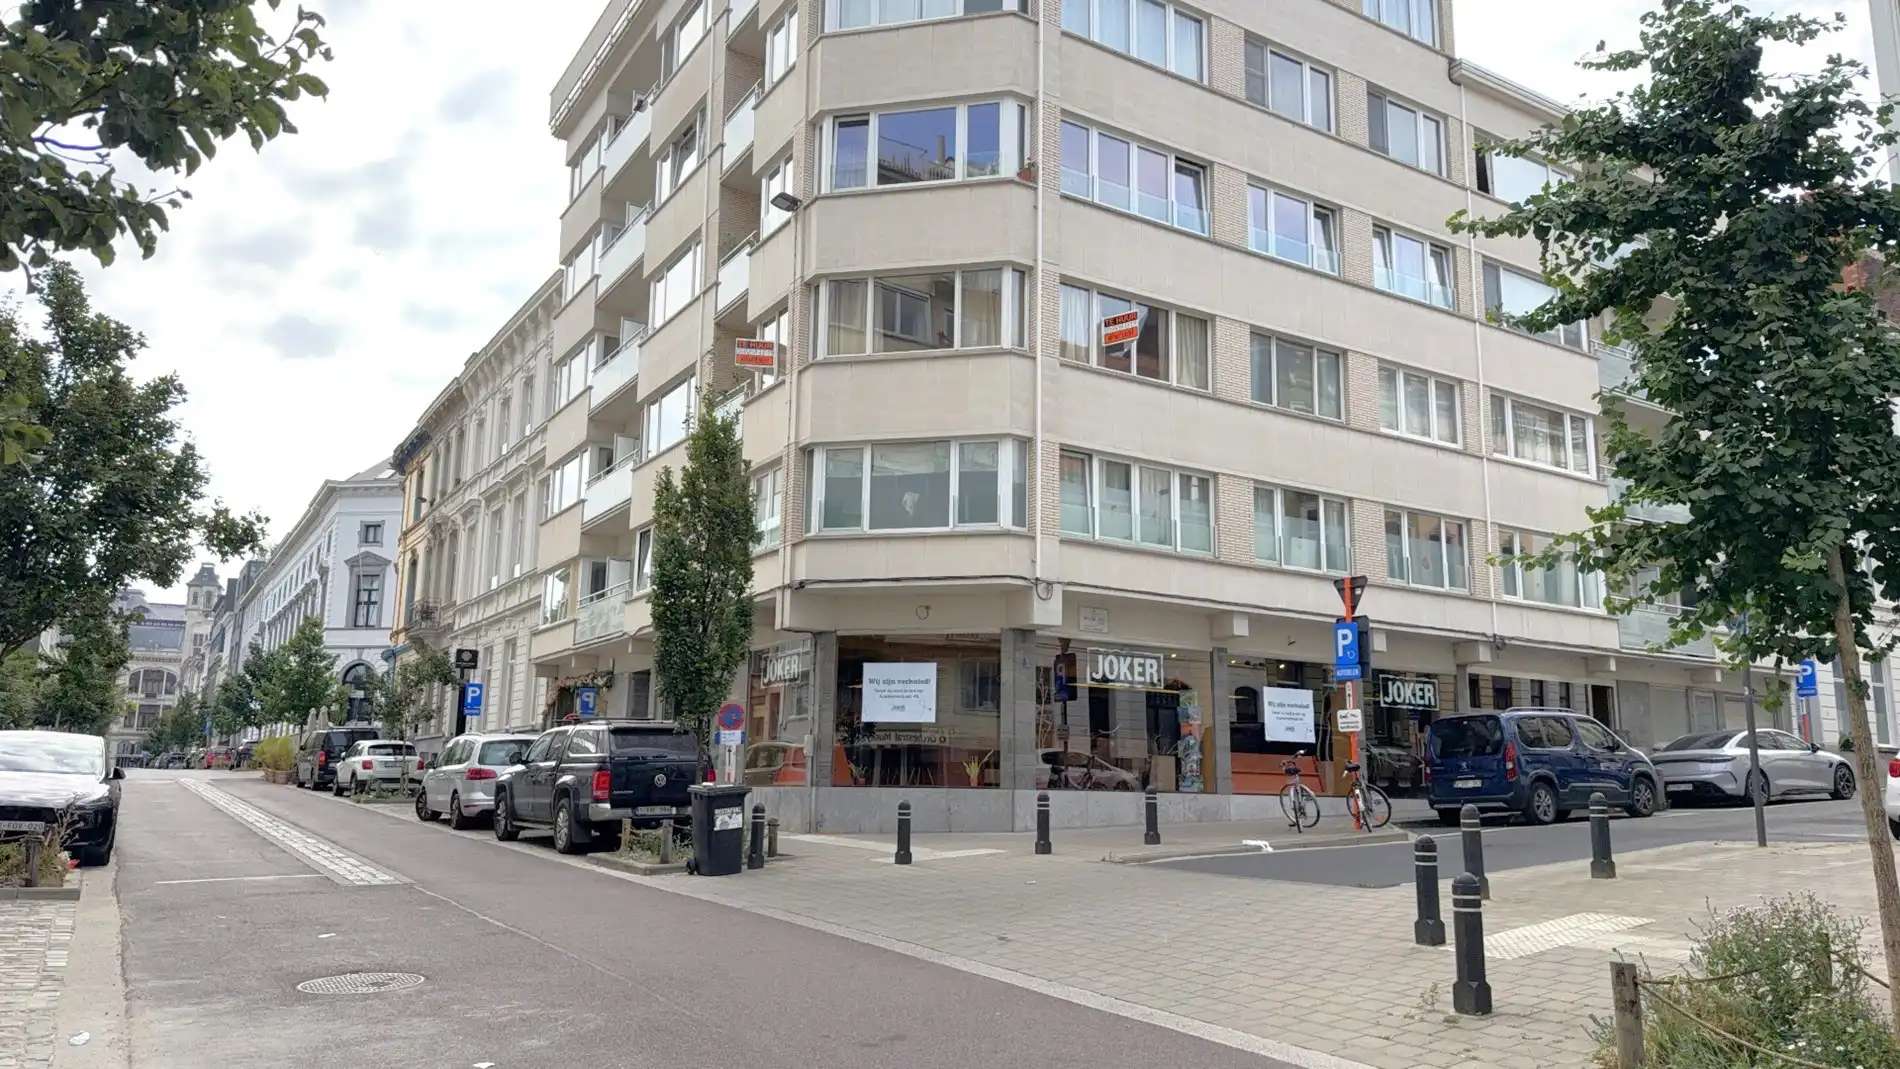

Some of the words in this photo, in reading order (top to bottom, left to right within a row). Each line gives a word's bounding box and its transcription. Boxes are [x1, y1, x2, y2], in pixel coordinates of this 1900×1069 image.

[1337, 628, 1353, 657] P
[764, 654, 799, 684] JOKER
[868, 677, 881, 686] Wij
[882, 677, 896, 686] zijn
[897, 677, 931, 685] verhuisd!
[1091, 654, 1159, 684] JOKER
[1798, 664, 1812, 684] P
[467, 687, 481, 703] P
[1384, 680, 1436, 706] JOKER
